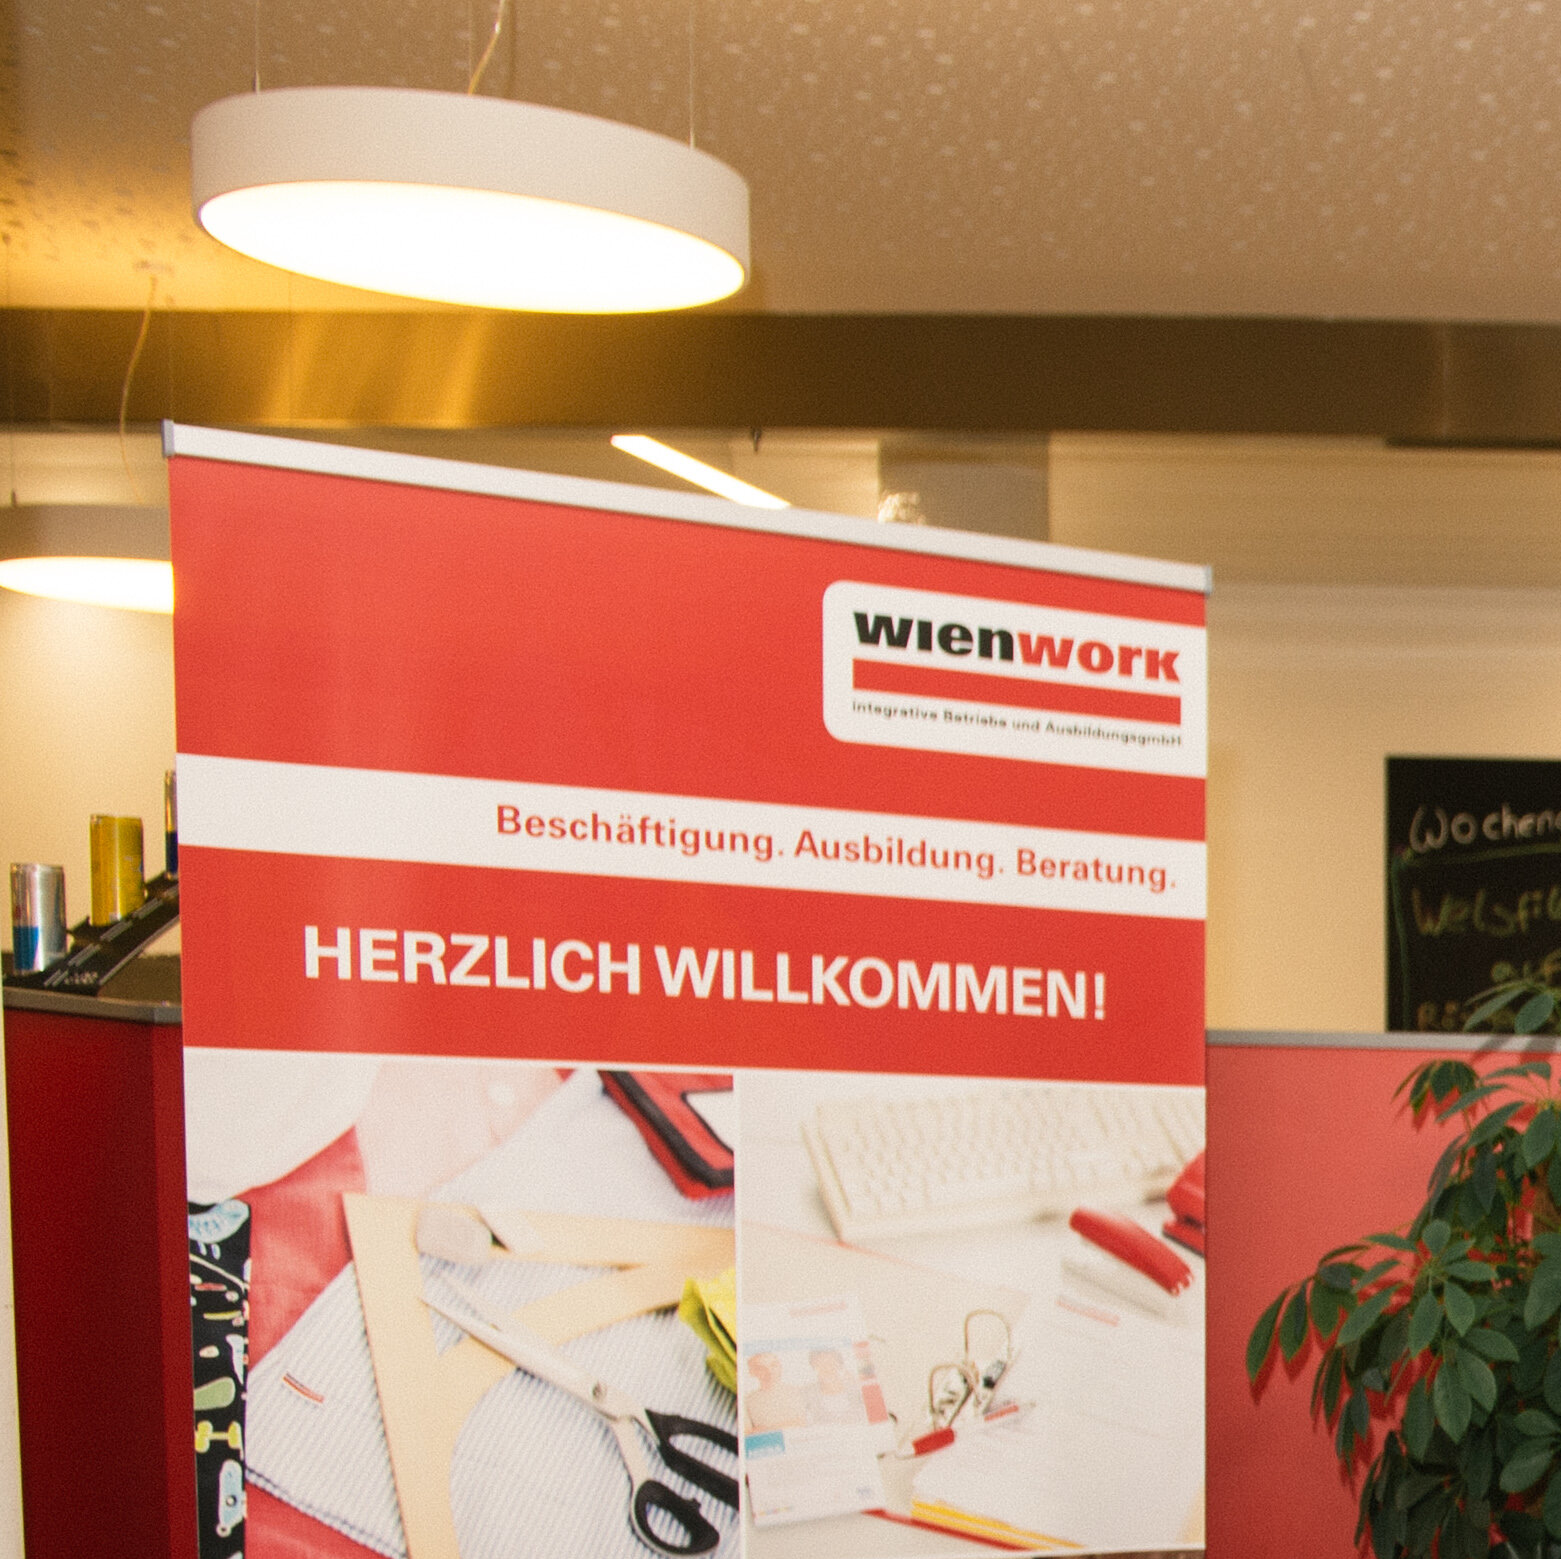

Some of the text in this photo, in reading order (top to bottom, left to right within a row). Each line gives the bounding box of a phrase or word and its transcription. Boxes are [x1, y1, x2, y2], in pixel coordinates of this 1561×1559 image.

[853, 611, 1181, 683] wienwork
[943, 710, 1007, 727] Betriebe
[1012, 720, 1040, 731] und
[496, 804, 1177, 893] Beschäftigung. Ausbildung. Beratung.
[304, 924, 1106, 1020] HERZLICH WILLKOMMEN!
